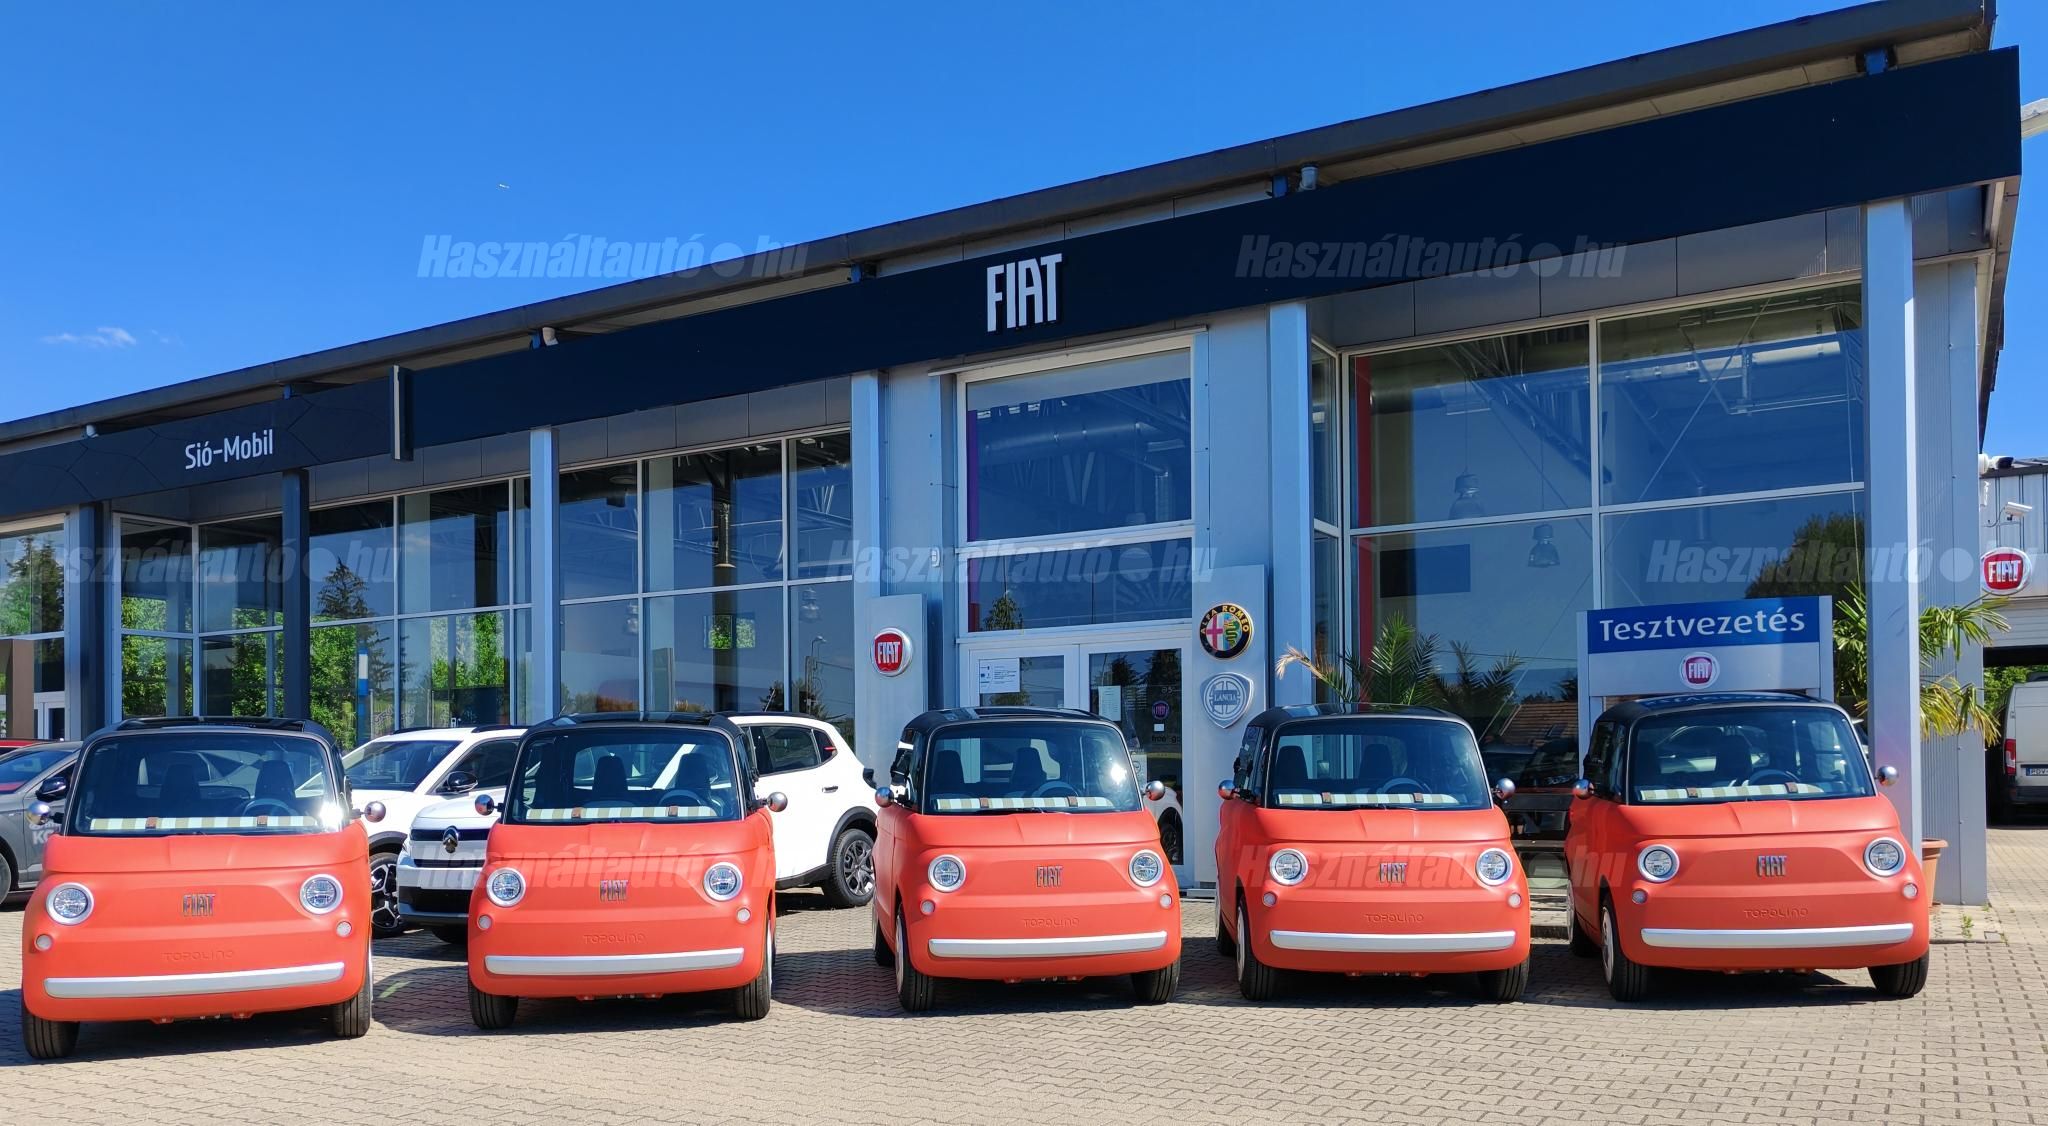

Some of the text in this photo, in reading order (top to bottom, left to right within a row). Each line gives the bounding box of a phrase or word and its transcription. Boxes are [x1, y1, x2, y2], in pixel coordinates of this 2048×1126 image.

[987, 253, 1063, 332] FIAT
[185, 429, 273, 469] Sió-Mobil
[1987, 560, 2021, 582] FIAT
[1200, 605, 1250, 634] ALFA ROMEO
[1600, 607, 1805, 641] Tesztvezetés
[878, 641, 900, 664] FIAT
[1689, 662, 1711, 679] FIAT
[1213, 693, 1238, 702] LANCIA
[1036, 866, 1063, 888] FIAT
[1379, 863, 1408, 883] FIAT
[1757, 855, 1787, 877] FIAT
[600, 879, 628, 902] FIAT
[182, 893, 216, 917] FIAT
